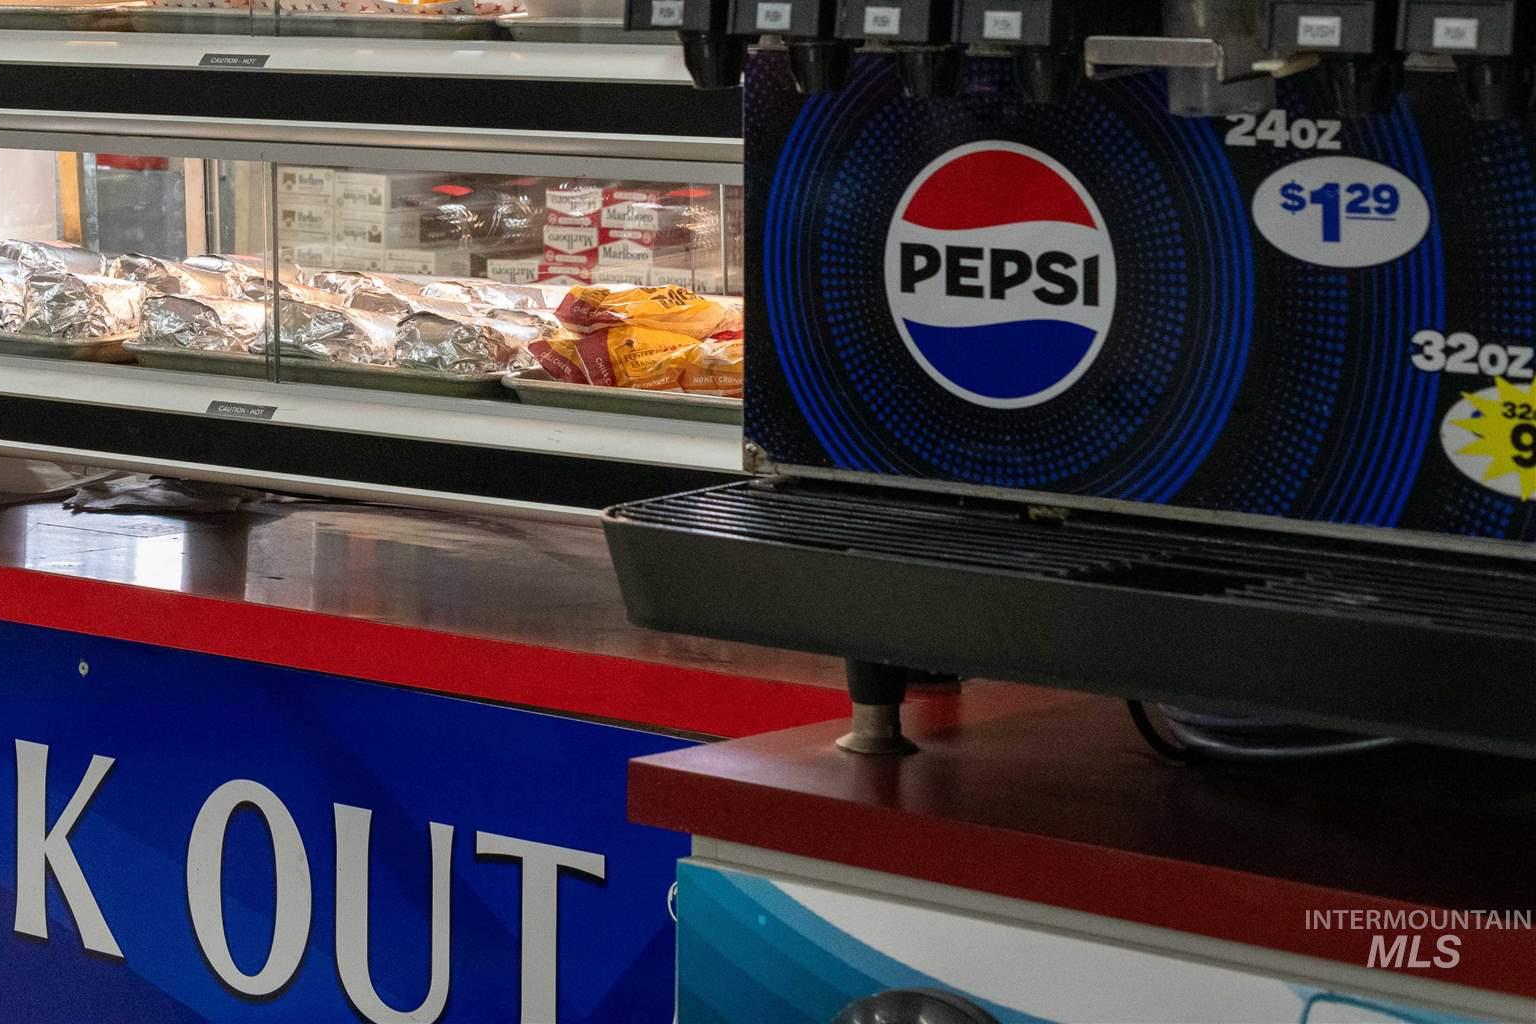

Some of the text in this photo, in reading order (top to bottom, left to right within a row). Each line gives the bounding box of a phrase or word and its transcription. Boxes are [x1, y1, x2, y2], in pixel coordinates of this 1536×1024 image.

[1302, 26, 1336, 38] PUSH
[1225, 109, 1342, 150] 24oz
[606, 202, 655, 224] Marlboro
[602, 244, 651, 263] Marlboro
[898, 241, 1101, 308] PEPSI
[1411, 330, 1534, 378] 32oz
[718, 376, 743, 385] CRUNC
[218, 405, 264, 416] CAUTION HOT
[186, 778, 606, 1024] OUT
